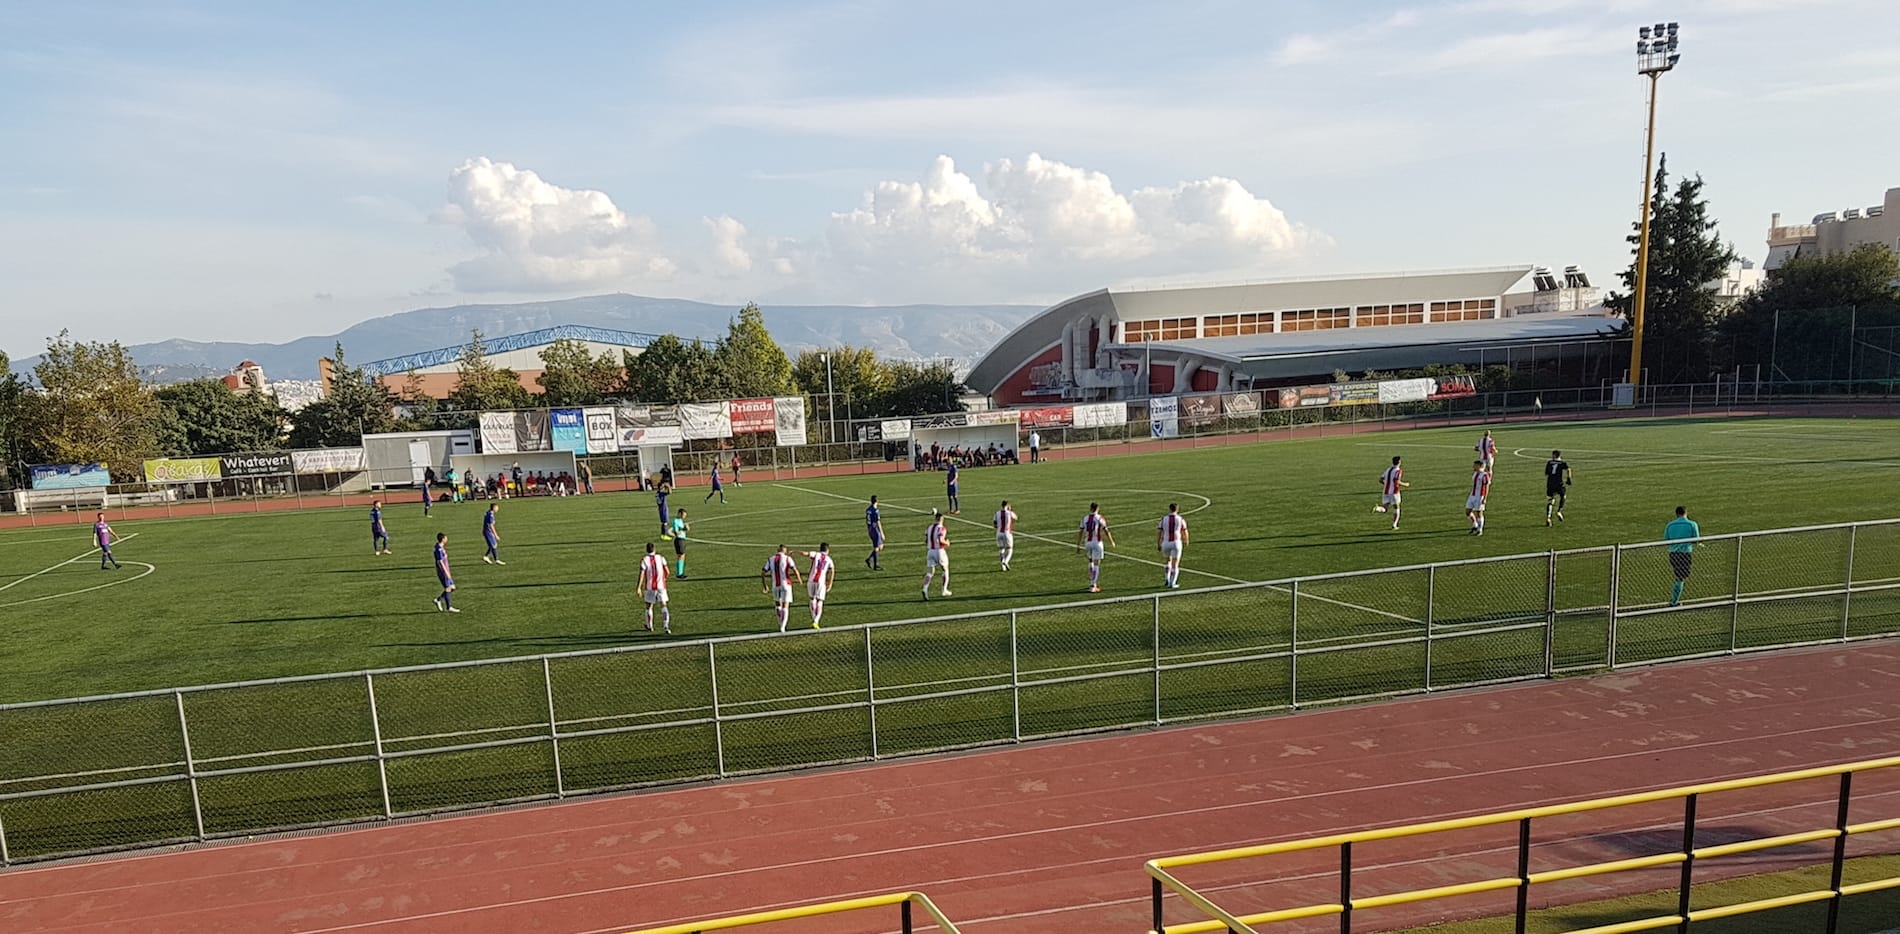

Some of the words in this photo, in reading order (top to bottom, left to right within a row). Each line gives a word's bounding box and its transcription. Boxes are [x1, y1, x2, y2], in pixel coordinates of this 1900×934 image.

[730, 401, 773, 412] Friends
[592, 422, 614, 431] BOX
[223, 456, 290, 469] Whatever!
[1551, 463, 1559, 475] 1
